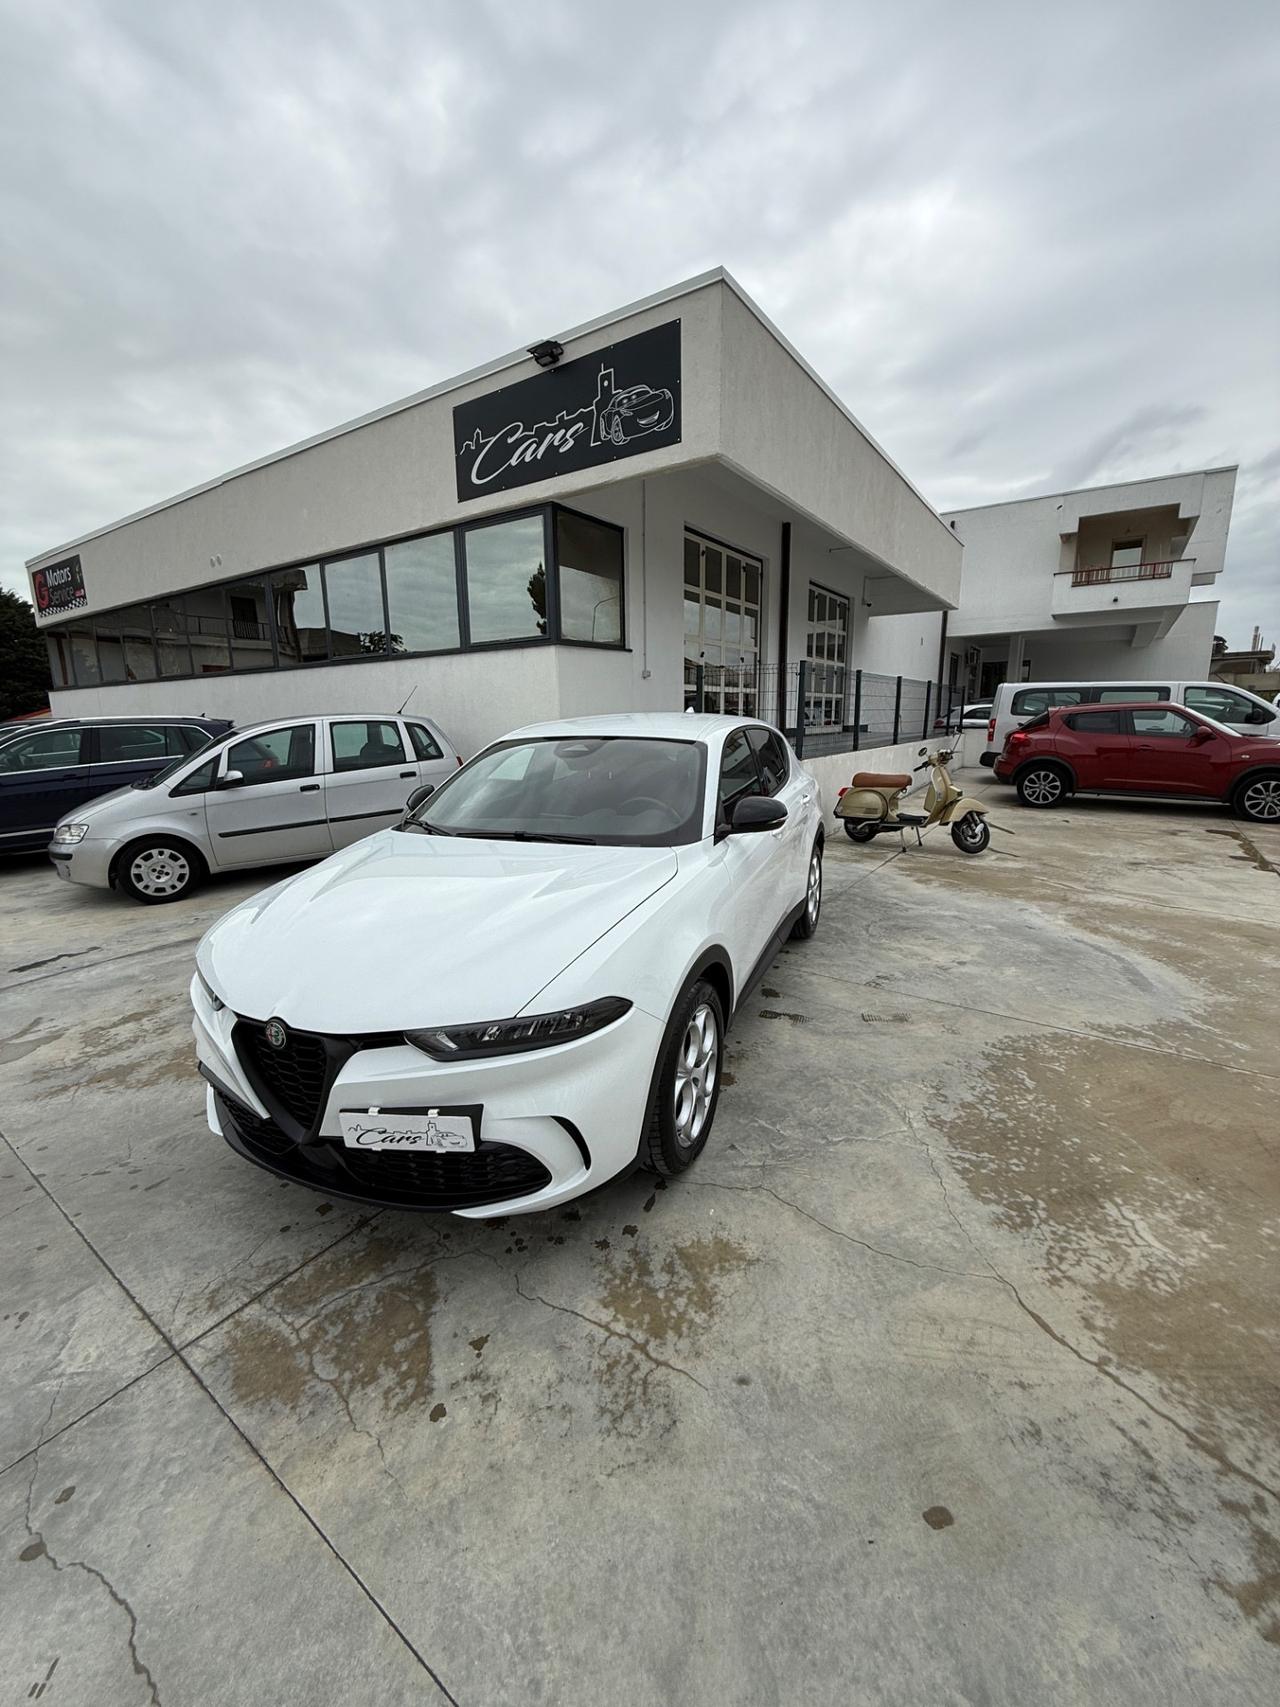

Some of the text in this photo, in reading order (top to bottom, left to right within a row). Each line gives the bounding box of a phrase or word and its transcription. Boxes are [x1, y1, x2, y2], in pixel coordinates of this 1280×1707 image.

[471, 422, 590, 485] Cars
[46, 567, 72, 587] Motors
[356, 1127, 422, 1145] Cars
